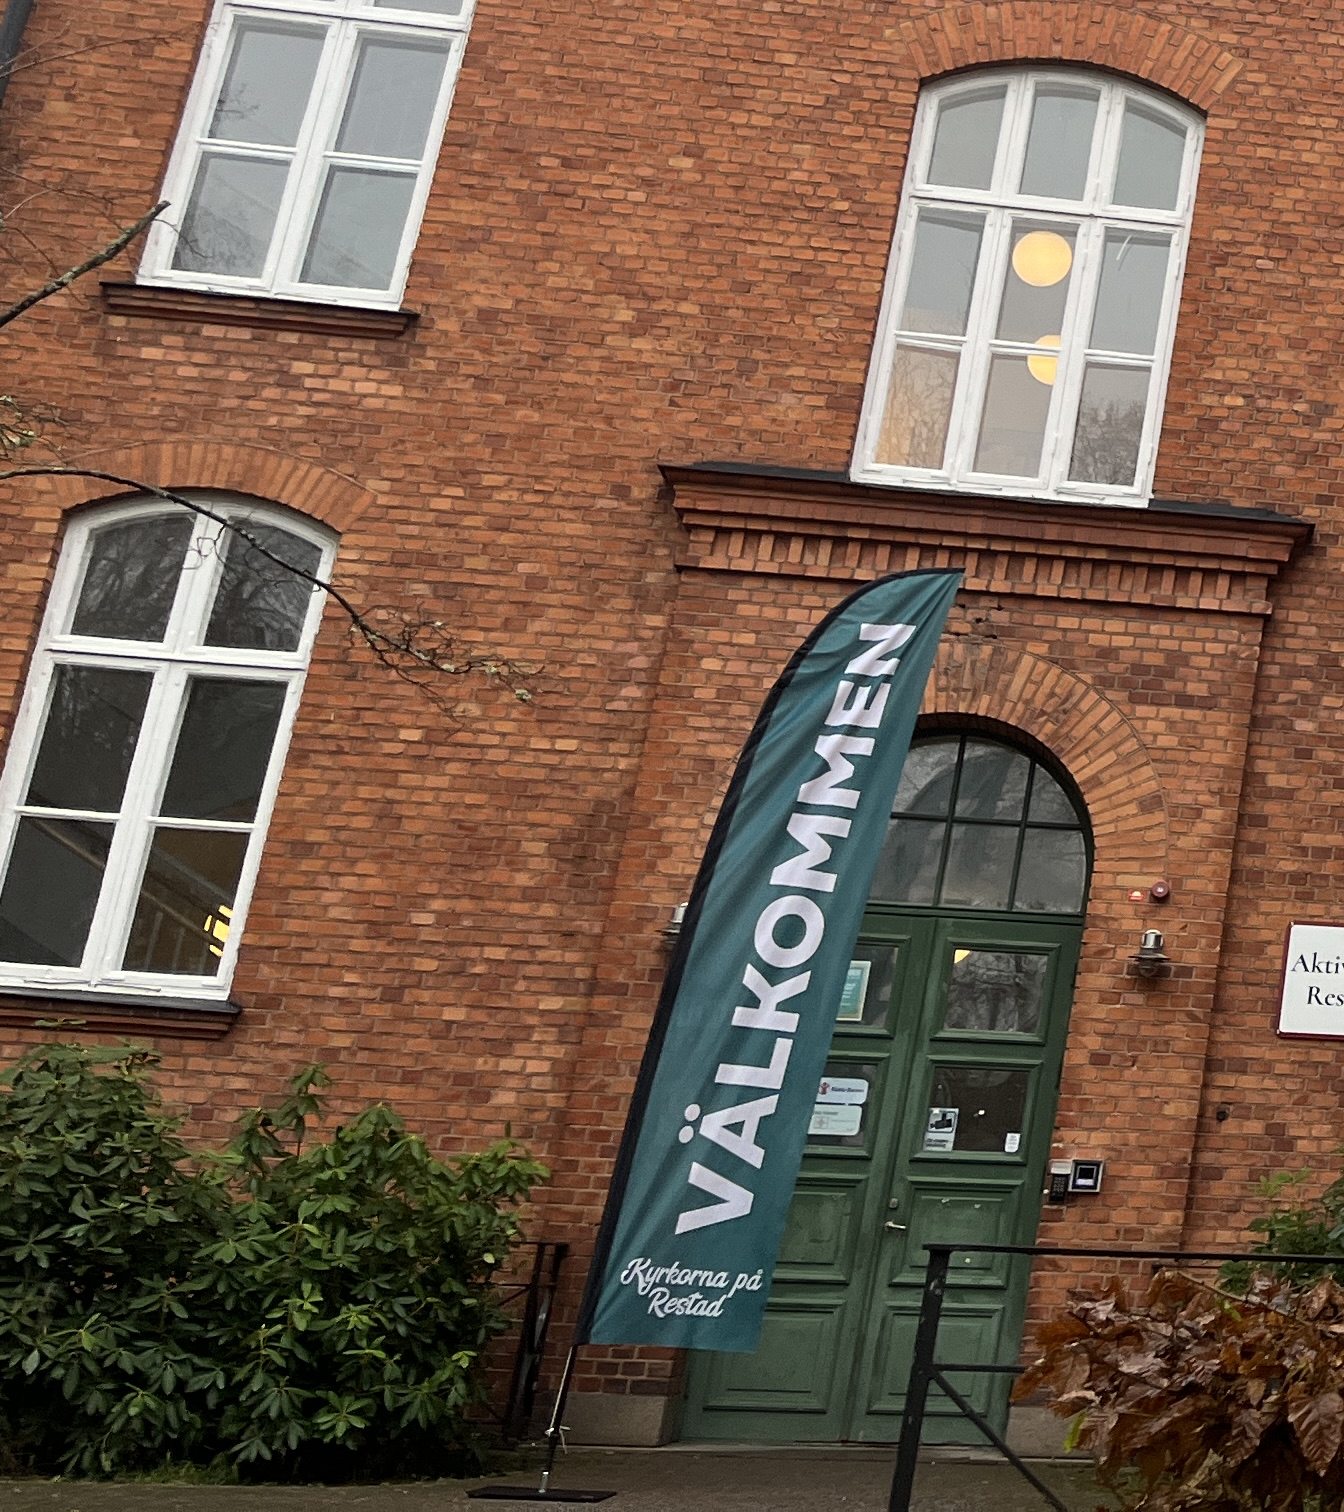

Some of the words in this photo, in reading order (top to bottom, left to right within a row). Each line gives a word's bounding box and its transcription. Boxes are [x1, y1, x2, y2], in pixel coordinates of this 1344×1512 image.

[674, 622, 917, 1235] VÄLKOMMEN
[620, 1257, 730, 1296] Kyrkorna
[727, 1268, 764, 1299] på
[647, 1286, 728, 1318] Restad
